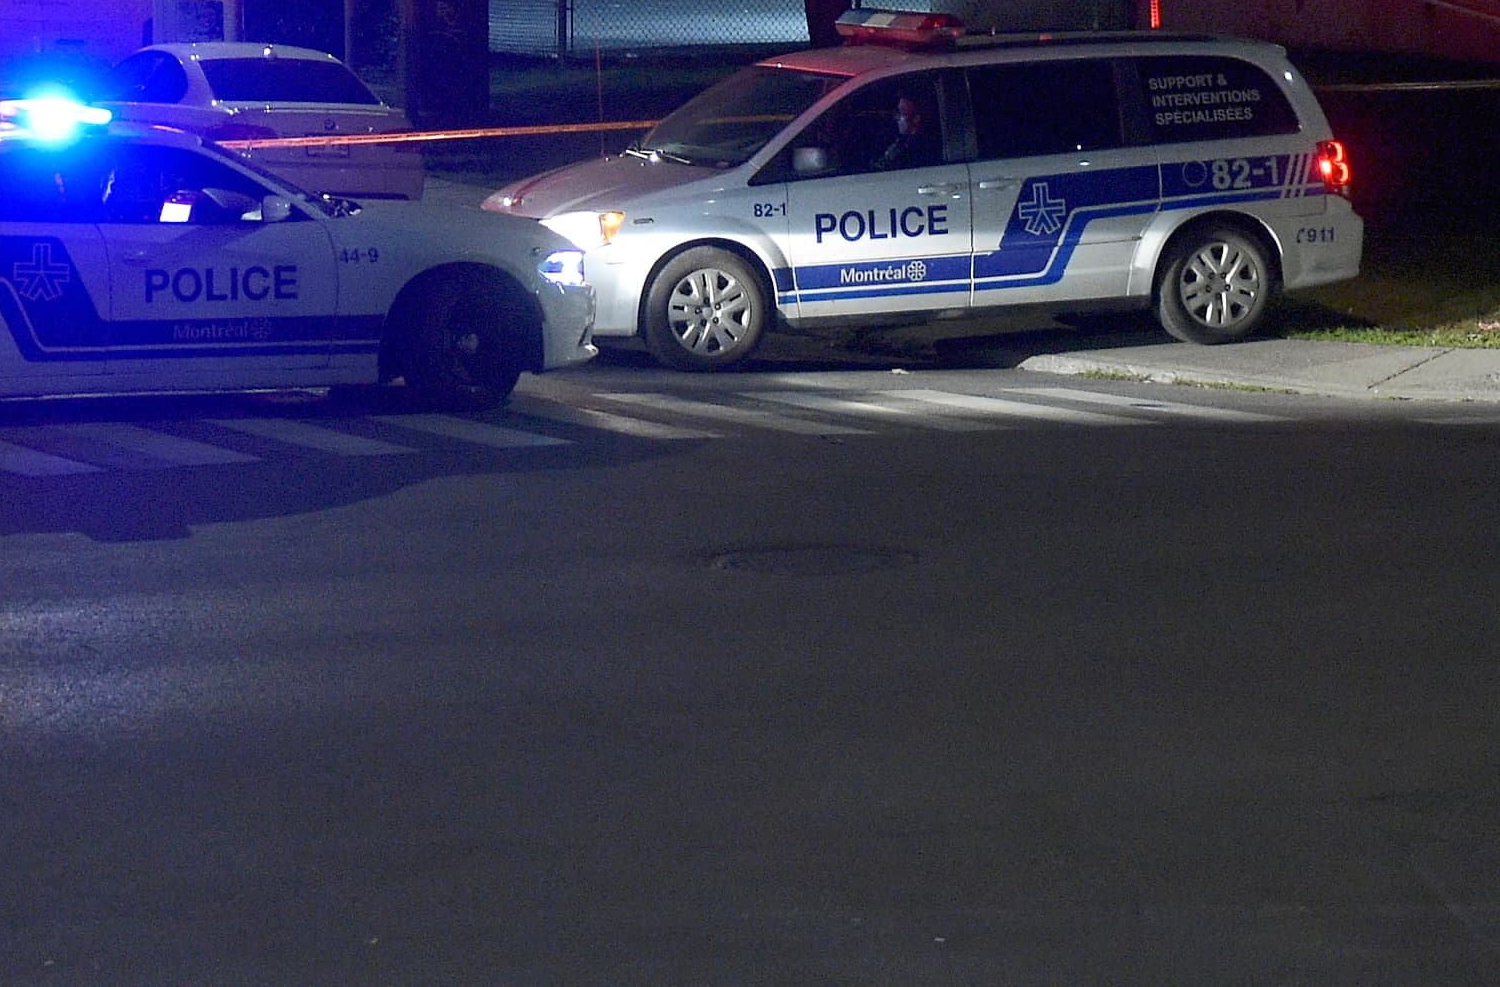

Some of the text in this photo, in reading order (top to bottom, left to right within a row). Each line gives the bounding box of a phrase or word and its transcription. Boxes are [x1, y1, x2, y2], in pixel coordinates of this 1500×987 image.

[1148, 73, 1228, 91] SUPPORT &
[1152, 88, 1260, 108] INTERVENTIONS
[1211, 156, 1279, 190] 82-1
[753, 203, 786, 217] 82-1
[815, 205, 949, 243] POLICE
[1307, 227, 1335, 243] 911
[339, 247, 379, 263] 44-9
[145, 265, 298, 303] POLICE
[840, 266, 906, 284] Montréal
